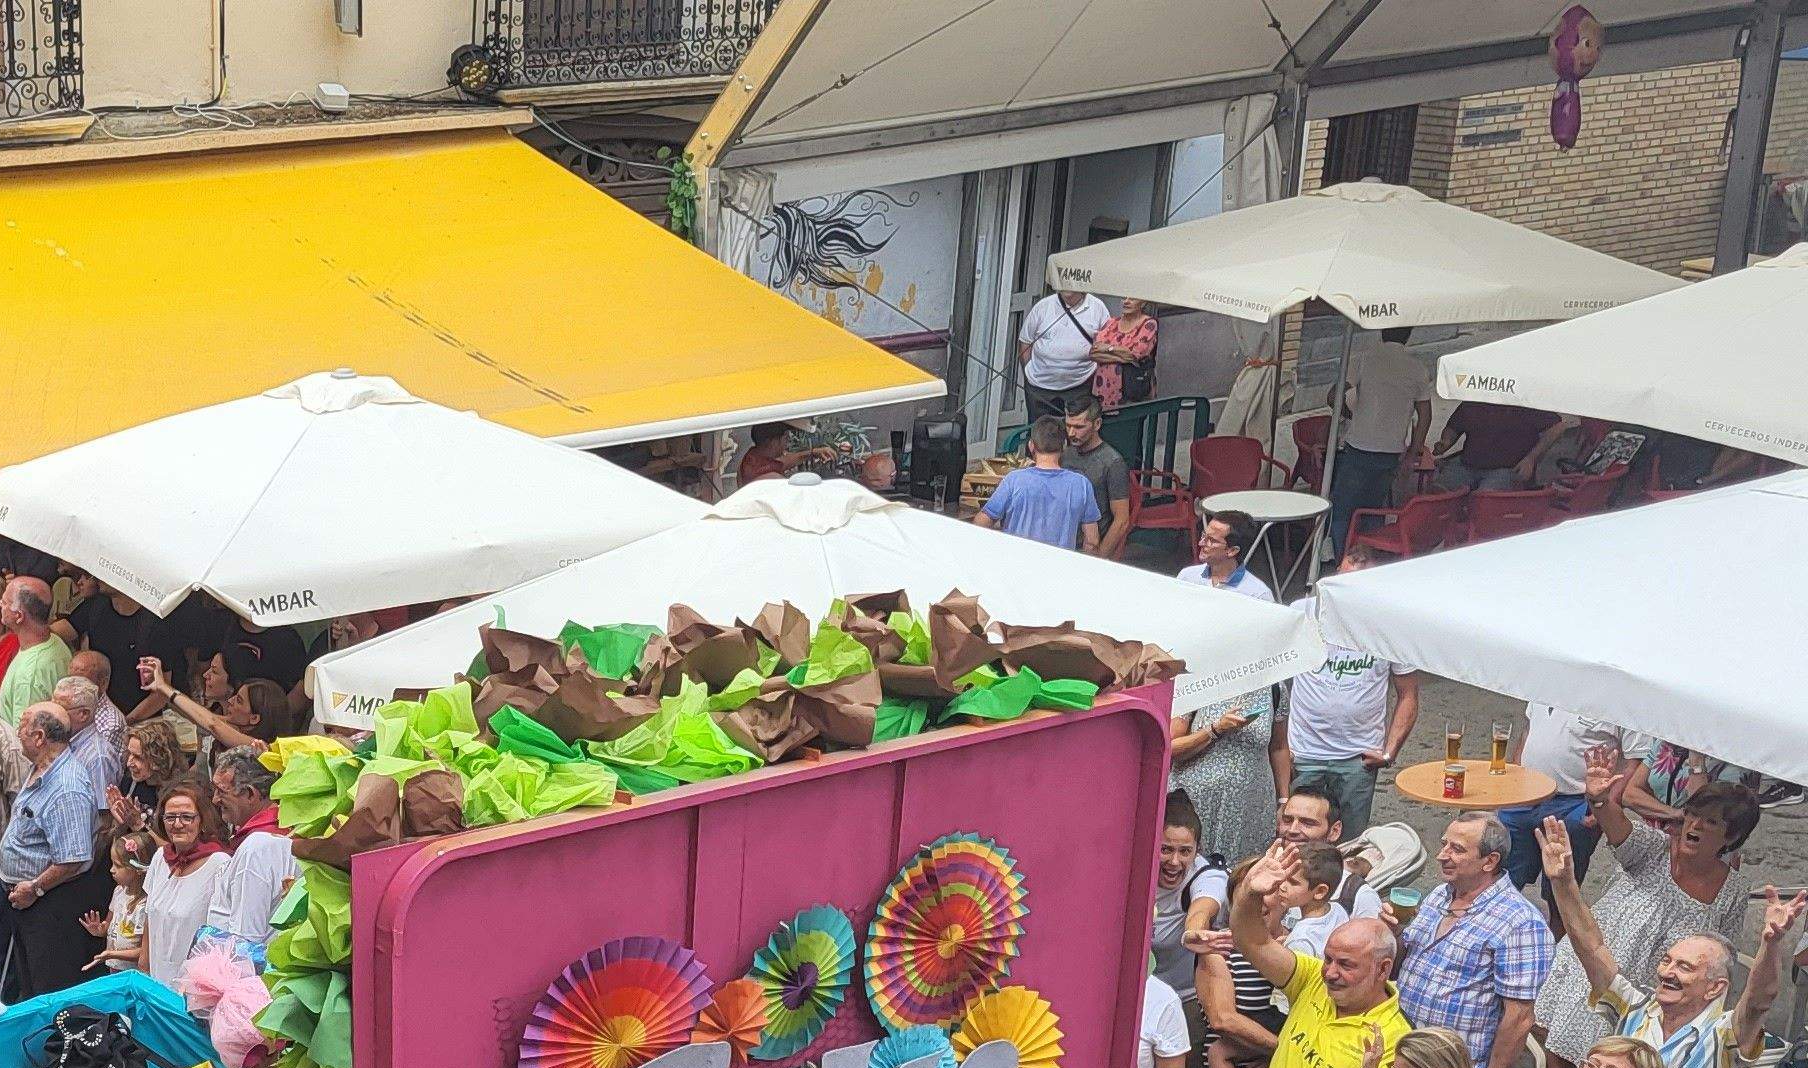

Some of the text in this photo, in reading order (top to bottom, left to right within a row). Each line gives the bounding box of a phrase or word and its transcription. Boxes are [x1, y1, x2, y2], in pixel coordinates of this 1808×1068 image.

[1062, 267, 1092, 283] AMBAR
[1358, 302, 1400, 319] MBAR
[1563, 300, 1615, 309] CERVECEROS
[1466, 374, 1516, 394] AMBAR
[1704, 420, 1771, 443] CERVECEROS
[248, 589, 318, 616] AMBAR
[1220, 649, 1299, 684] INDEPENDIENTES
